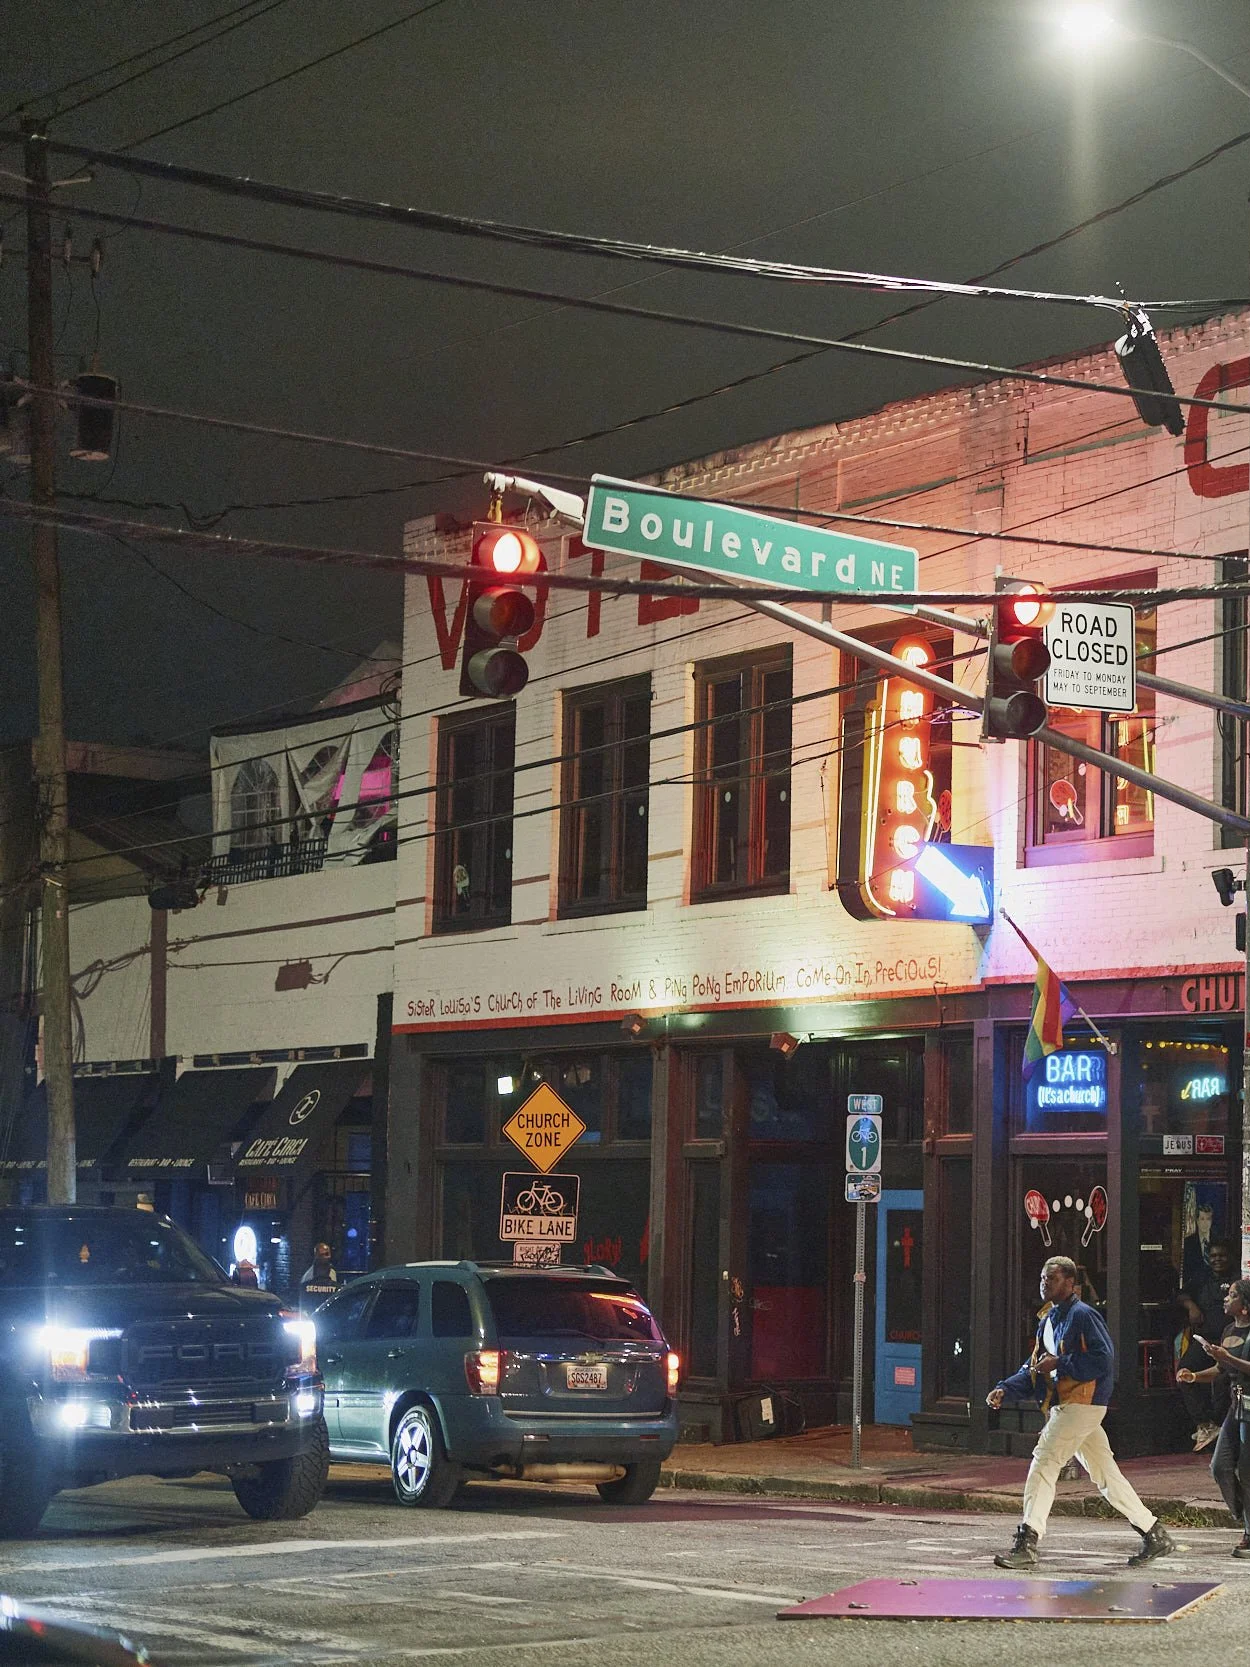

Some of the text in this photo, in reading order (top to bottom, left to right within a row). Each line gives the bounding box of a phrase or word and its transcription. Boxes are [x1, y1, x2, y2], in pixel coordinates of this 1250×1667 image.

[601, 497, 904, 591] Boulevard NE
[1062, 612, 1117, 638] ROAD
[1052, 638, 1128, 666] CLOSED
[1053, 668, 1126, 684] FRIDAY TO MONDAY
[1053, 682, 1127, 698] MAY TO SEPTEMBER
[649, 979, 657, 1000] &
[1046, 1054, 1091, 1082] BAR
[853, 1098, 877, 1111] WEST
[517, 1113, 570, 1129] CHURCH
[525, 1132, 562, 1148] ZONE
[861, 1146, 867, 1168] 1
[505, 1219, 572, 1236] BIKE LANE
[306, 1285, 337, 1293] SECURITY
